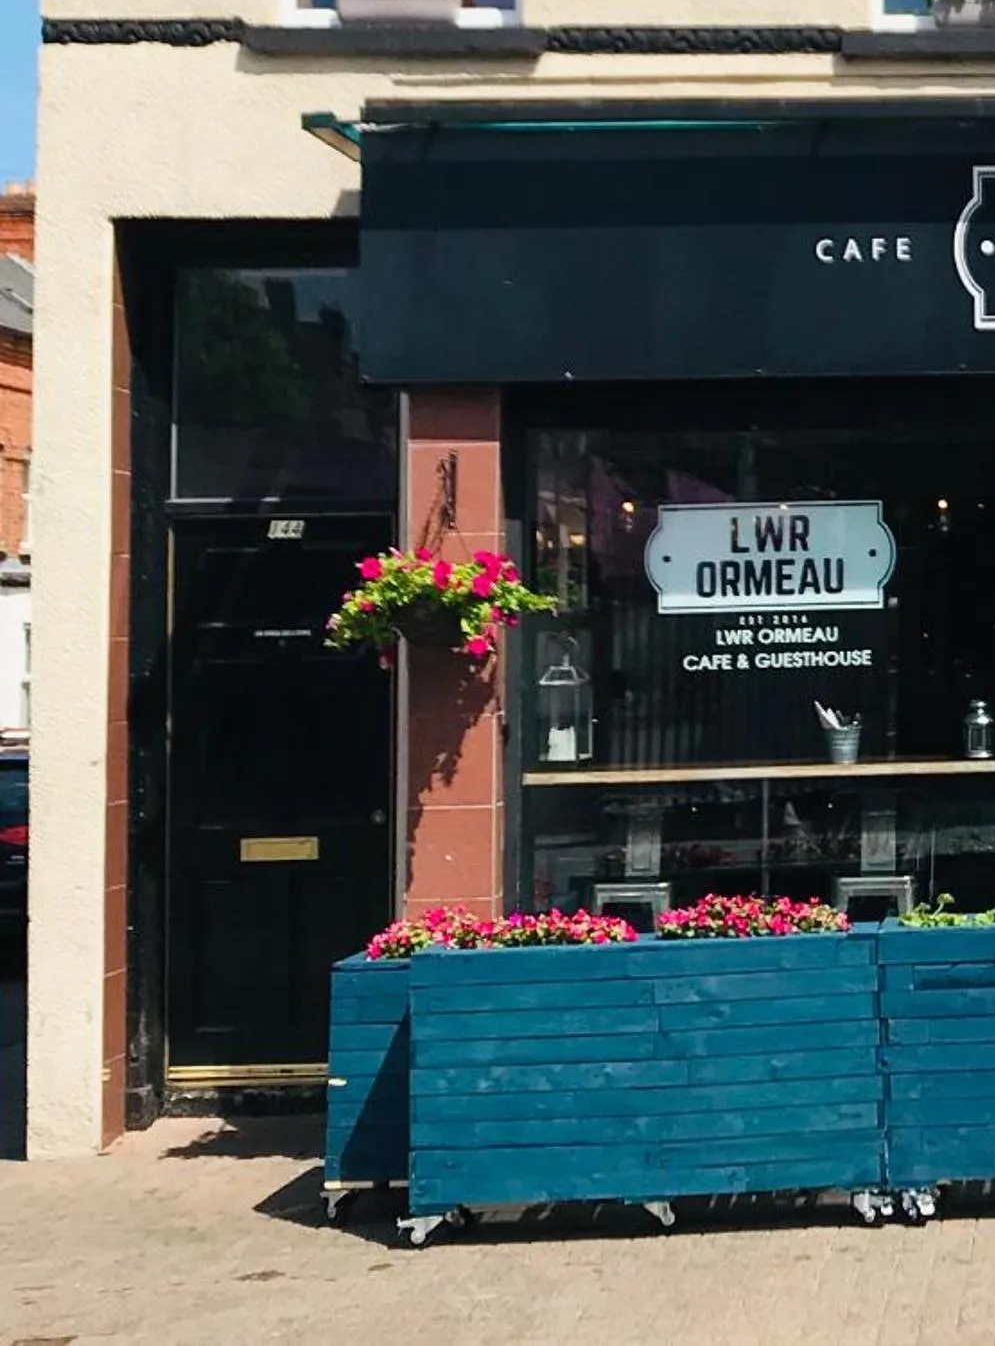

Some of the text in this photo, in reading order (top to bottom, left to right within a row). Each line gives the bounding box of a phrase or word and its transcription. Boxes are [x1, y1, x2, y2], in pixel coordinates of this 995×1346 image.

[815, 237, 914, 262] CAFE
[730, 514, 810, 554] LWR
[696, 557, 844, 598] ORMEAU
[715, 625, 840, 646] LWR ORMEAU
[683, 649, 873, 672] CAFE & GUESTHOUSE
